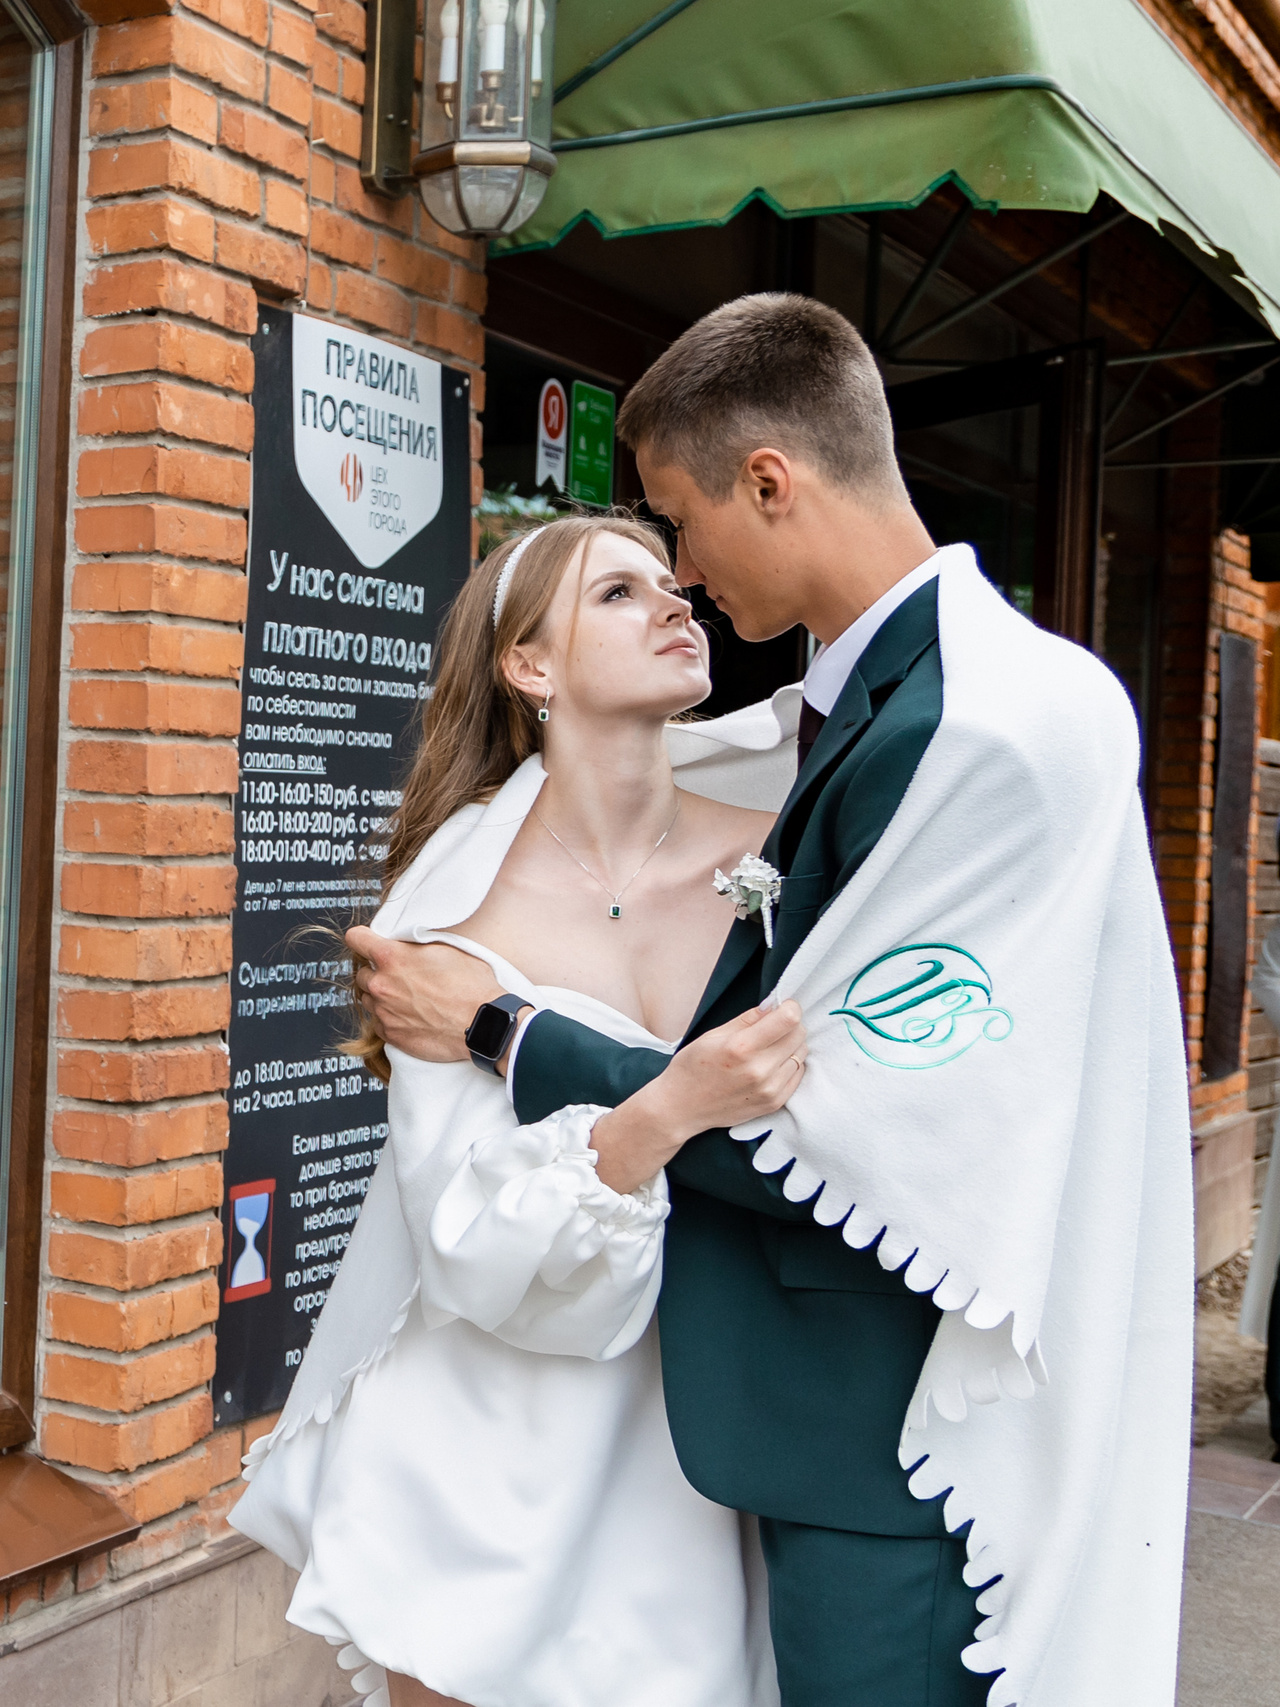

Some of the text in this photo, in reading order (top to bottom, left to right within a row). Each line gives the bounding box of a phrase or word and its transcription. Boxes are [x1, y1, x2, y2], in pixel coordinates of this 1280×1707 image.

[325, 338, 420, 403] ПРАВИЛА
[301, 388, 437, 462] ПОСЕЩЕНИЯ
[371, 465, 388, 485] ЦЕХ
[370, 488, 401, 511] ЭТОГО
[369, 511, 407, 536] ГОРОДА
[266, 549, 425, 615] У нас система
[262, 621, 432, 674] платного входа
[249, 665, 286, 686] чтобы
[287, 670, 321, 689] сесть
[322, 674, 337, 691] за
[337, 676, 363, 694] стол
[363, 679, 372, 694] и
[372, 680, 417, 700] заказать
[247, 693, 357, 720] по себестоимости
[245, 723, 393, 749] вам необходимо сначала
[243, 752, 327, 772] оплатить вход:
[241, 780, 334, 805] 11:00-16:00-150
[333, 784, 359, 810] руб.
[360, 791, 370, 807] с
[241, 810, 332, 834] 16:00-18:00-200
[332, 812, 358, 837] руб.
[359, 816, 368, 834] с
[241, 839, 331, 863] 18:00-01:00-400
[331, 841, 357, 866] руб.
[243, 879, 265, 896] Дети
[264, 881, 276, 895] до
[276, 878, 282, 893] 7
[282, 880, 295, 892] лет
[295, 880, 306, 892] не
[252, 899, 261, 911] от
[261, 897, 267, 911] 7
[267, 899, 281, 911] лет
[238, 961, 318, 988] Существуют
[237, 998, 254, 1017] по
[255, 993, 307, 1019] времени
[233, 1069, 251, 1090] до
[254, 1060, 284, 1084] 18:00
[285, 1058, 323, 1078] столик
[324, 1055, 338, 1073] за
[233, 1096, 251, 1114] на
[251, 1090, 261, 1112] 2
[262, 1090, 296, 1109] часа,
[297, 1084, 332, 1104] после
[334, 1074, 362, 1098] 18:00
[292, 1134, 320, 1156] Если
[321, 1132, 336, 1150] вы
[335, 1125, 371, 1147] хотите
[298, 1157, 342, 1183] дольше
[342, 1150, 372, 1172] этого
[289, 1191, 304, 1208] то
[304, 1186, 326, 1208] при
[285, 1270, 301, 1289] по
[285, 1348, 302, 1368] по
